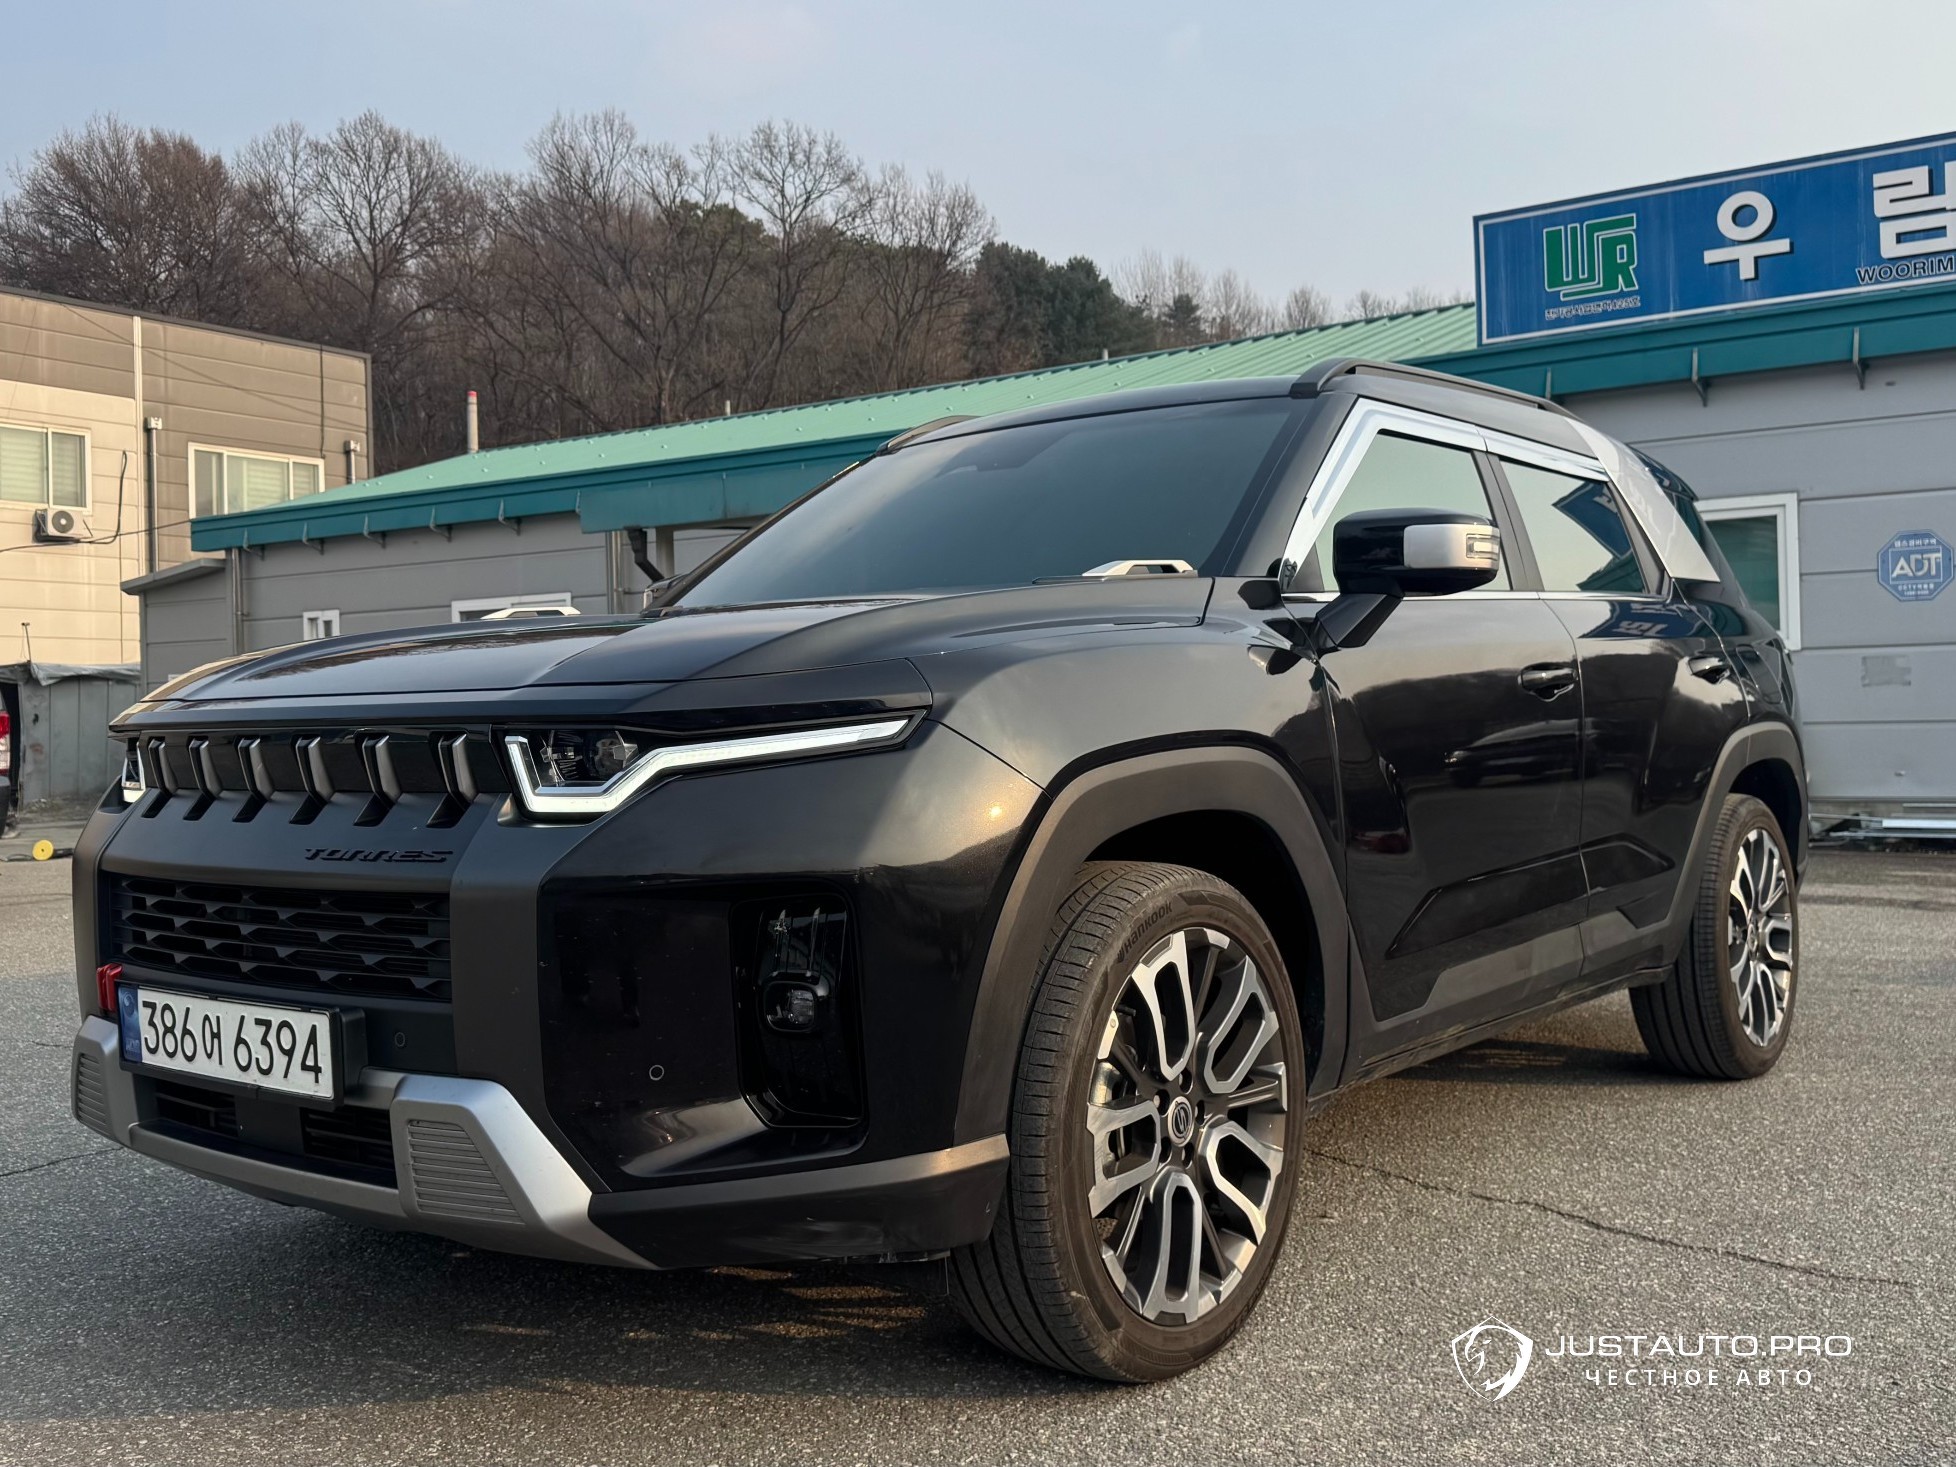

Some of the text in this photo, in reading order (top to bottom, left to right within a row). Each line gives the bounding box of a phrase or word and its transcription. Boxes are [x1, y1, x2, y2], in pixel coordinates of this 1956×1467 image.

[1855, 255, 1955, 285] WOORIM
[1891, 552, 1942, 578] ADT
[305, 848, 454, 863] TORRES
[142, 1000, 323, 1085] 386어 6394
